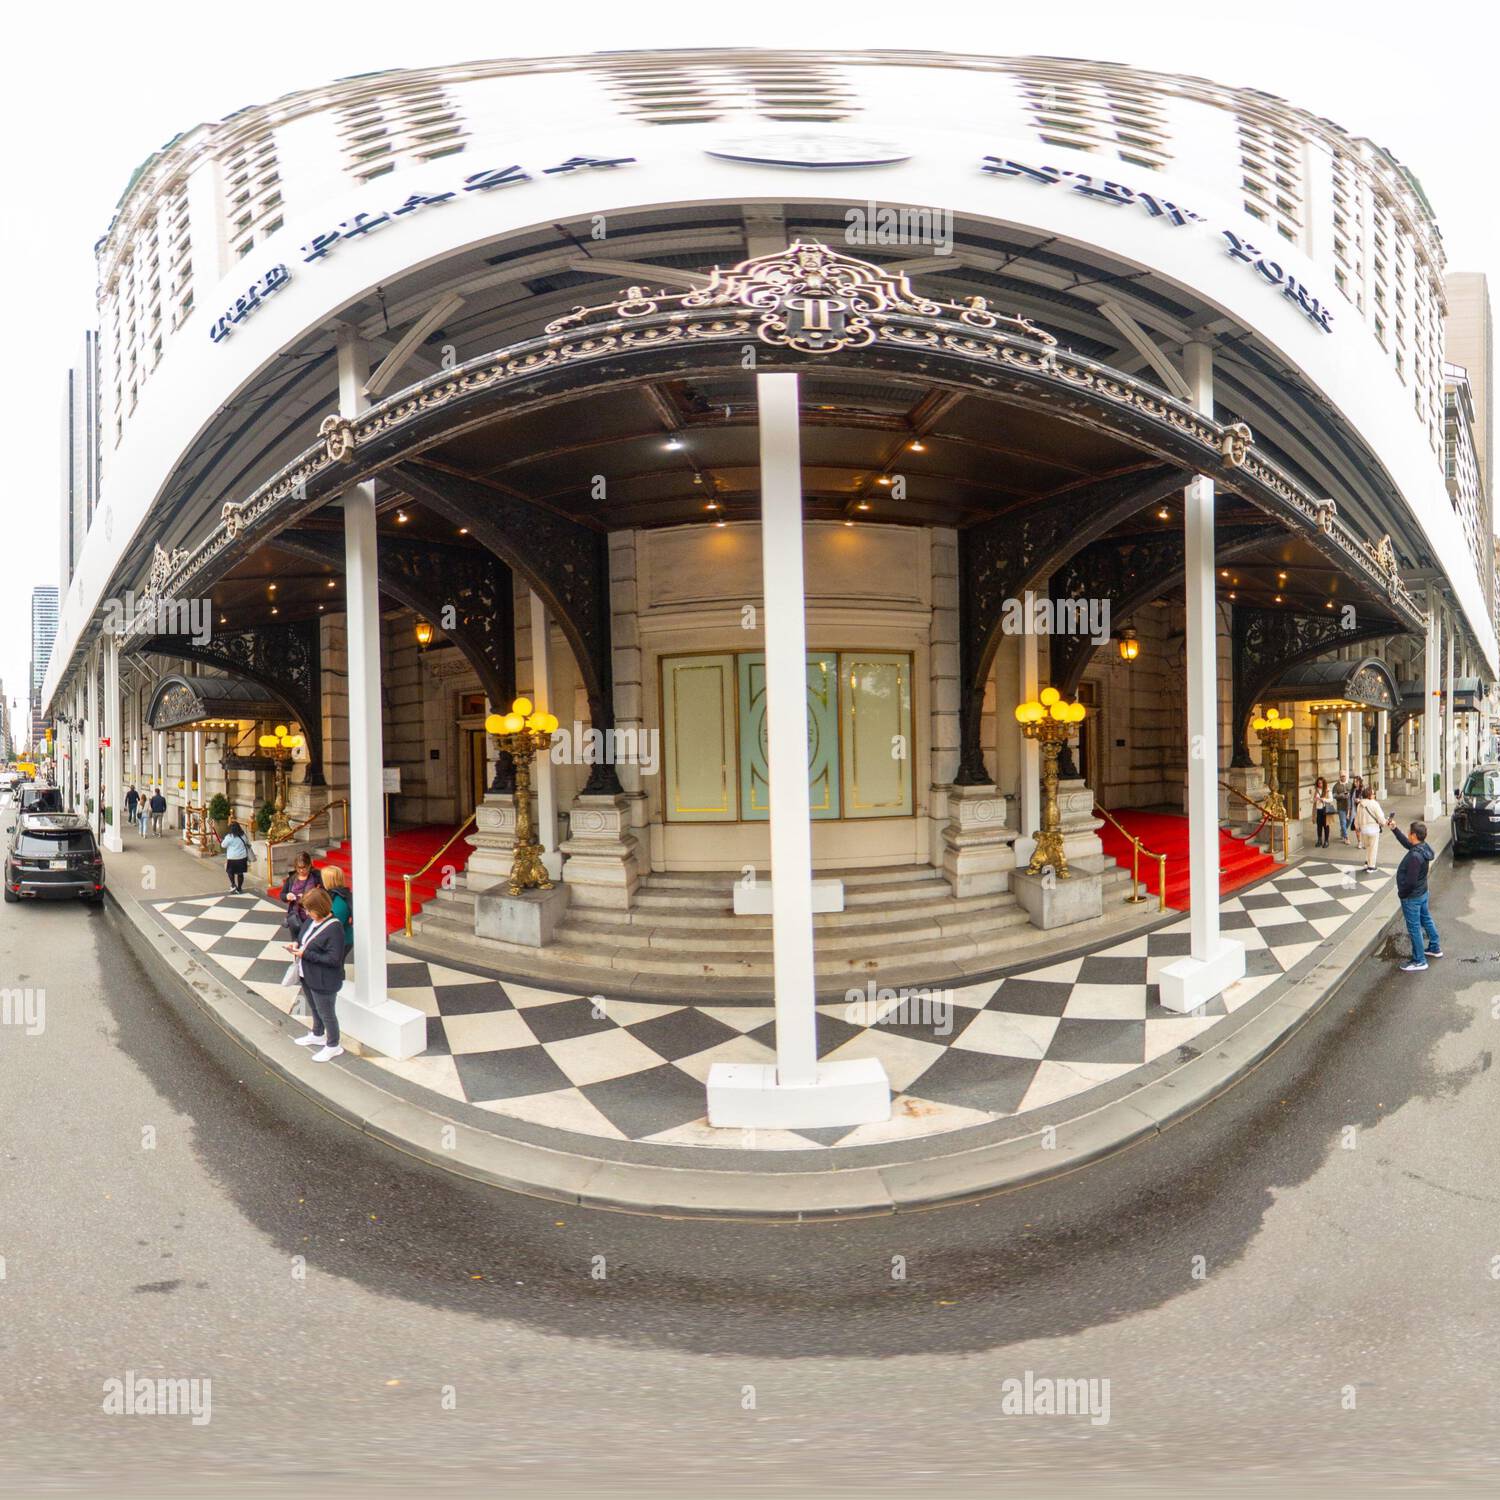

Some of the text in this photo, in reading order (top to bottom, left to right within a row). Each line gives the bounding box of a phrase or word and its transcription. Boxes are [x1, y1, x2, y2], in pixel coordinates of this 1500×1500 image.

[301, 157, 637, 263] PLAZA
[980, 156, 1336, 335] NEW YORK
